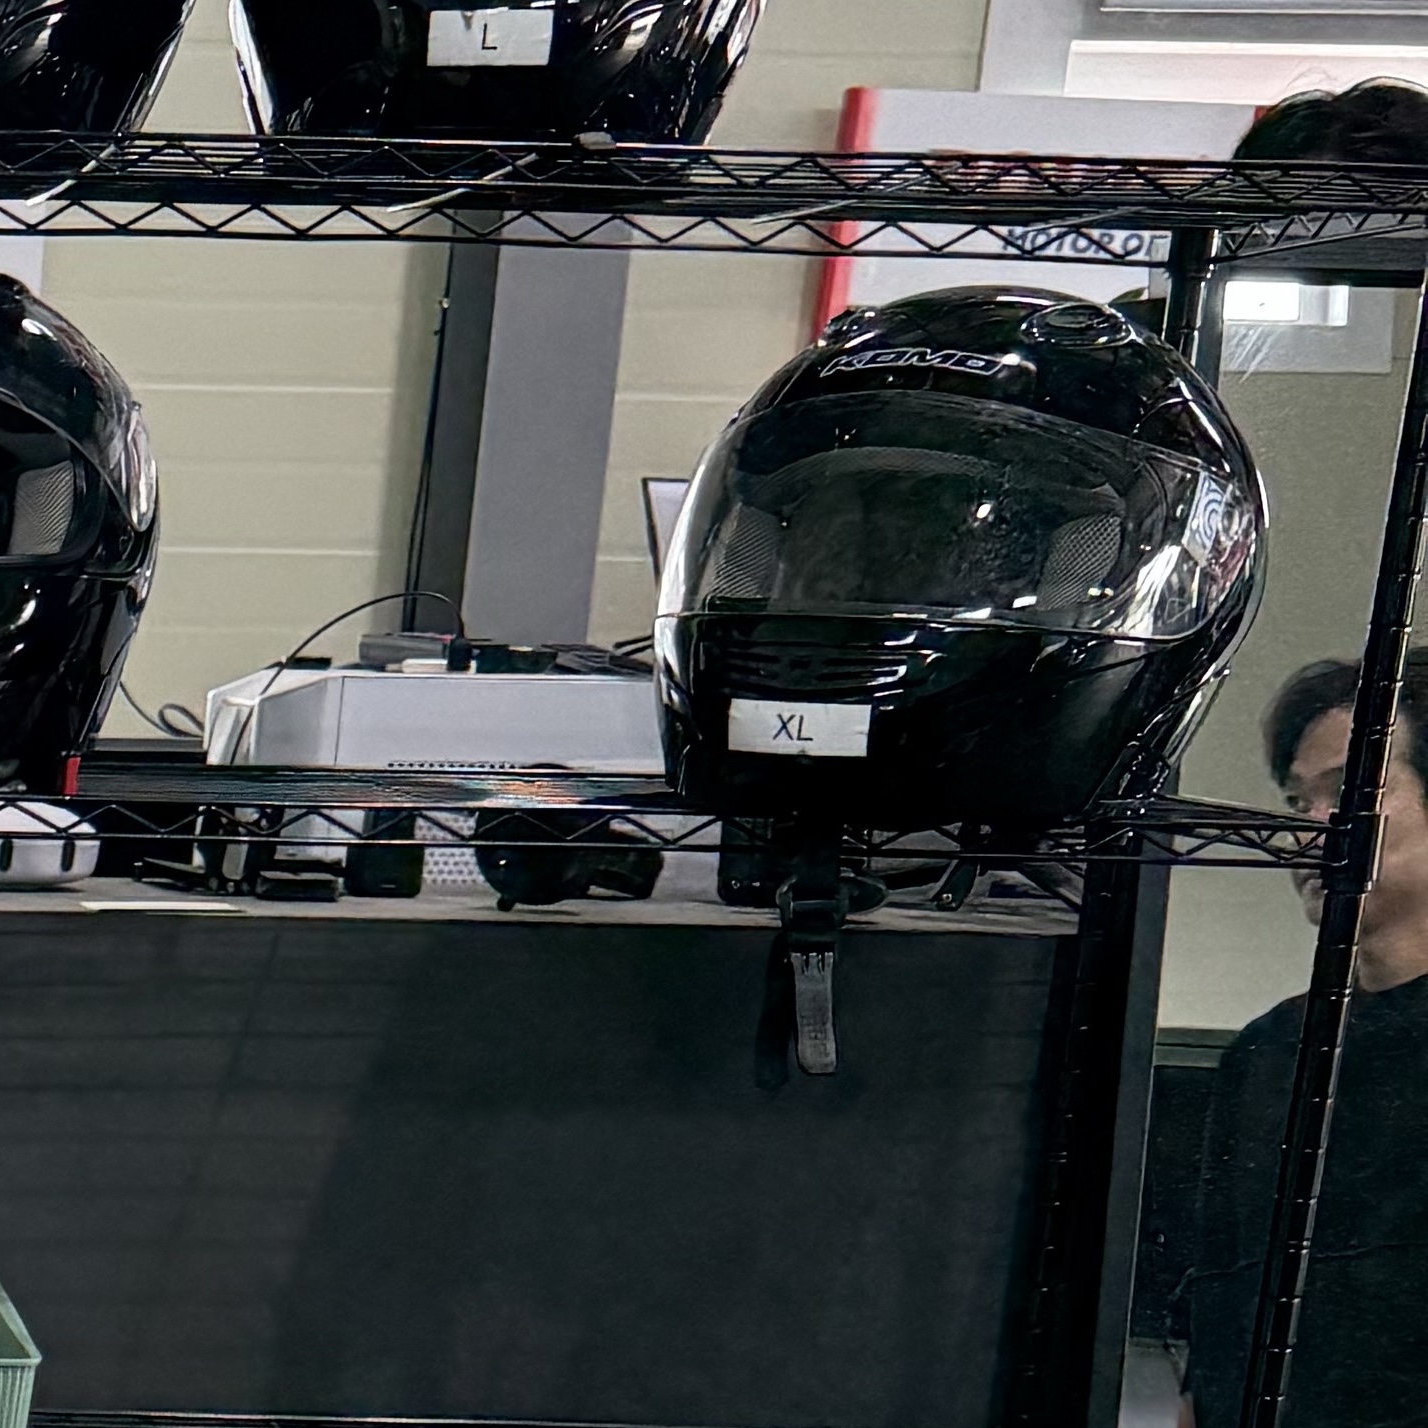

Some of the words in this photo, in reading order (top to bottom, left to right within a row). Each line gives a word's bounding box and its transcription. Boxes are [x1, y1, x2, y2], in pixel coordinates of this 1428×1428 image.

[481, 23, 498, 50] L
[819, 347, 1003, 377] KOMO
[772, 713, 814, 741] XL
